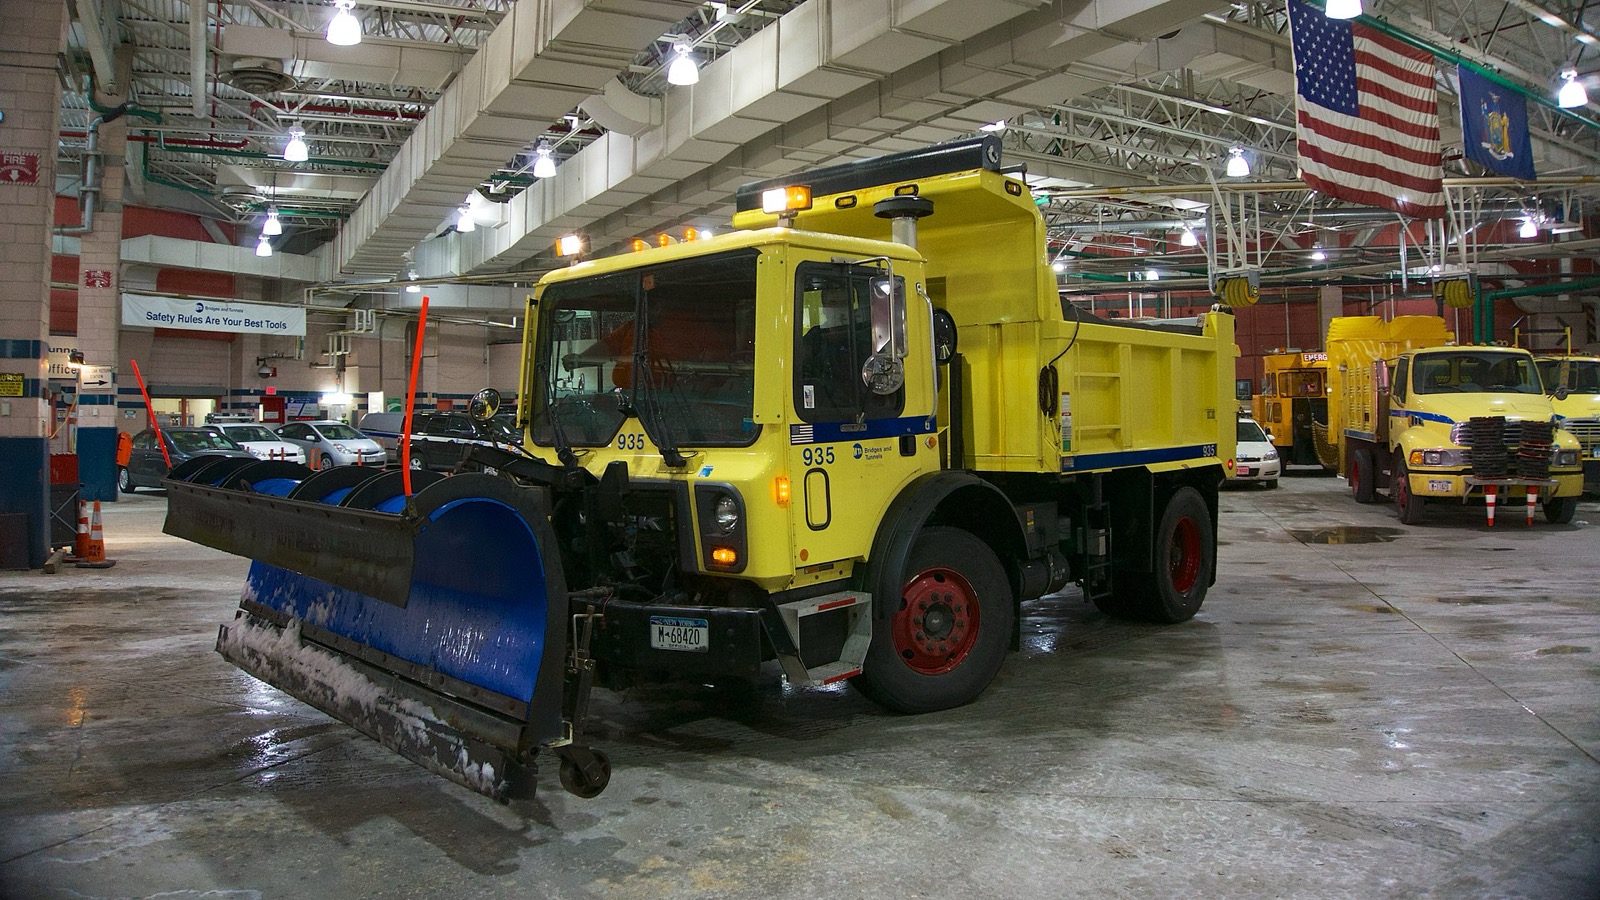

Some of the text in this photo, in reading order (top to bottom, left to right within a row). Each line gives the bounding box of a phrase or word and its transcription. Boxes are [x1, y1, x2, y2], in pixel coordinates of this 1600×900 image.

[3, 155, 26, 165] FIRE
[146, 311, 287, 330] Safety Rules Are Your Best Tools
[48, 363, 77, 374] ffice
[618, 433, 645, 450] 935
[803, 446, 835, 466] 935
[1202, 445, 1215, 457] 935
[658, 626, 700, 645] M-68420
